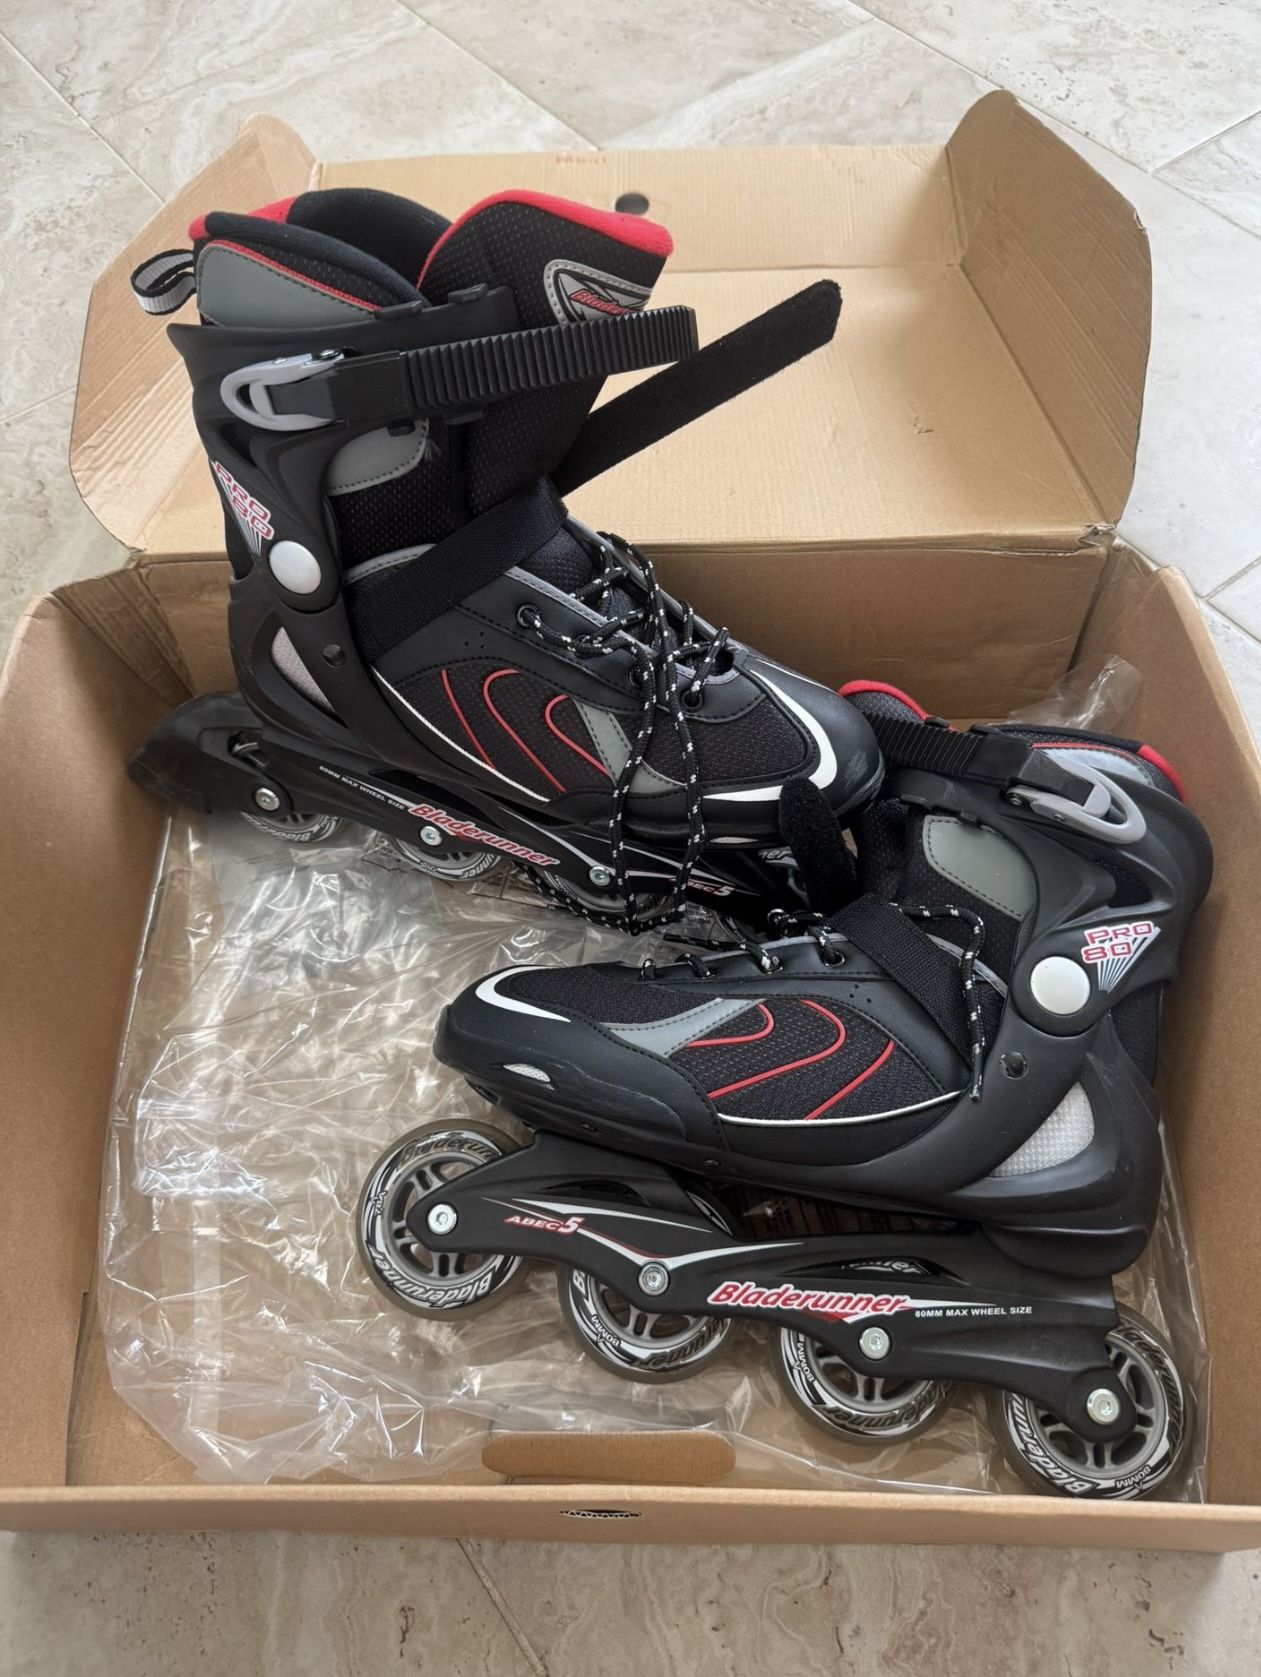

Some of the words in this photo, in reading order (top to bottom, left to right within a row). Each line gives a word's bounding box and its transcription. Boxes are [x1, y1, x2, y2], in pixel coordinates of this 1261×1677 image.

[213, 461, 271, 523] PRO
[341, 776, 360, 788] MAX
[359, 785, 387, 801] WHEEL
[386, 799, 406, 811] SIZE
[408, 803, 561, 866] Bladerunner
[1084, 921, 1154, 945] PRO
[1081, 940, 1132, 963] 80
[367, 1243, 494, 1308] Bladerunner
[707, 1280, 910, 1316] Bladerunner
[914, 1308, 943, 1318] 80MM
[945, 1307, 969, 1317] MAX
[970, 1306, 1007, 1316] WHEEL
[1009, 1305, 1033, 1315] SIZE
[1010, 1394, 1093, 1494] Bladerun
[1115, 1464, 1152, 1489] 80MM
